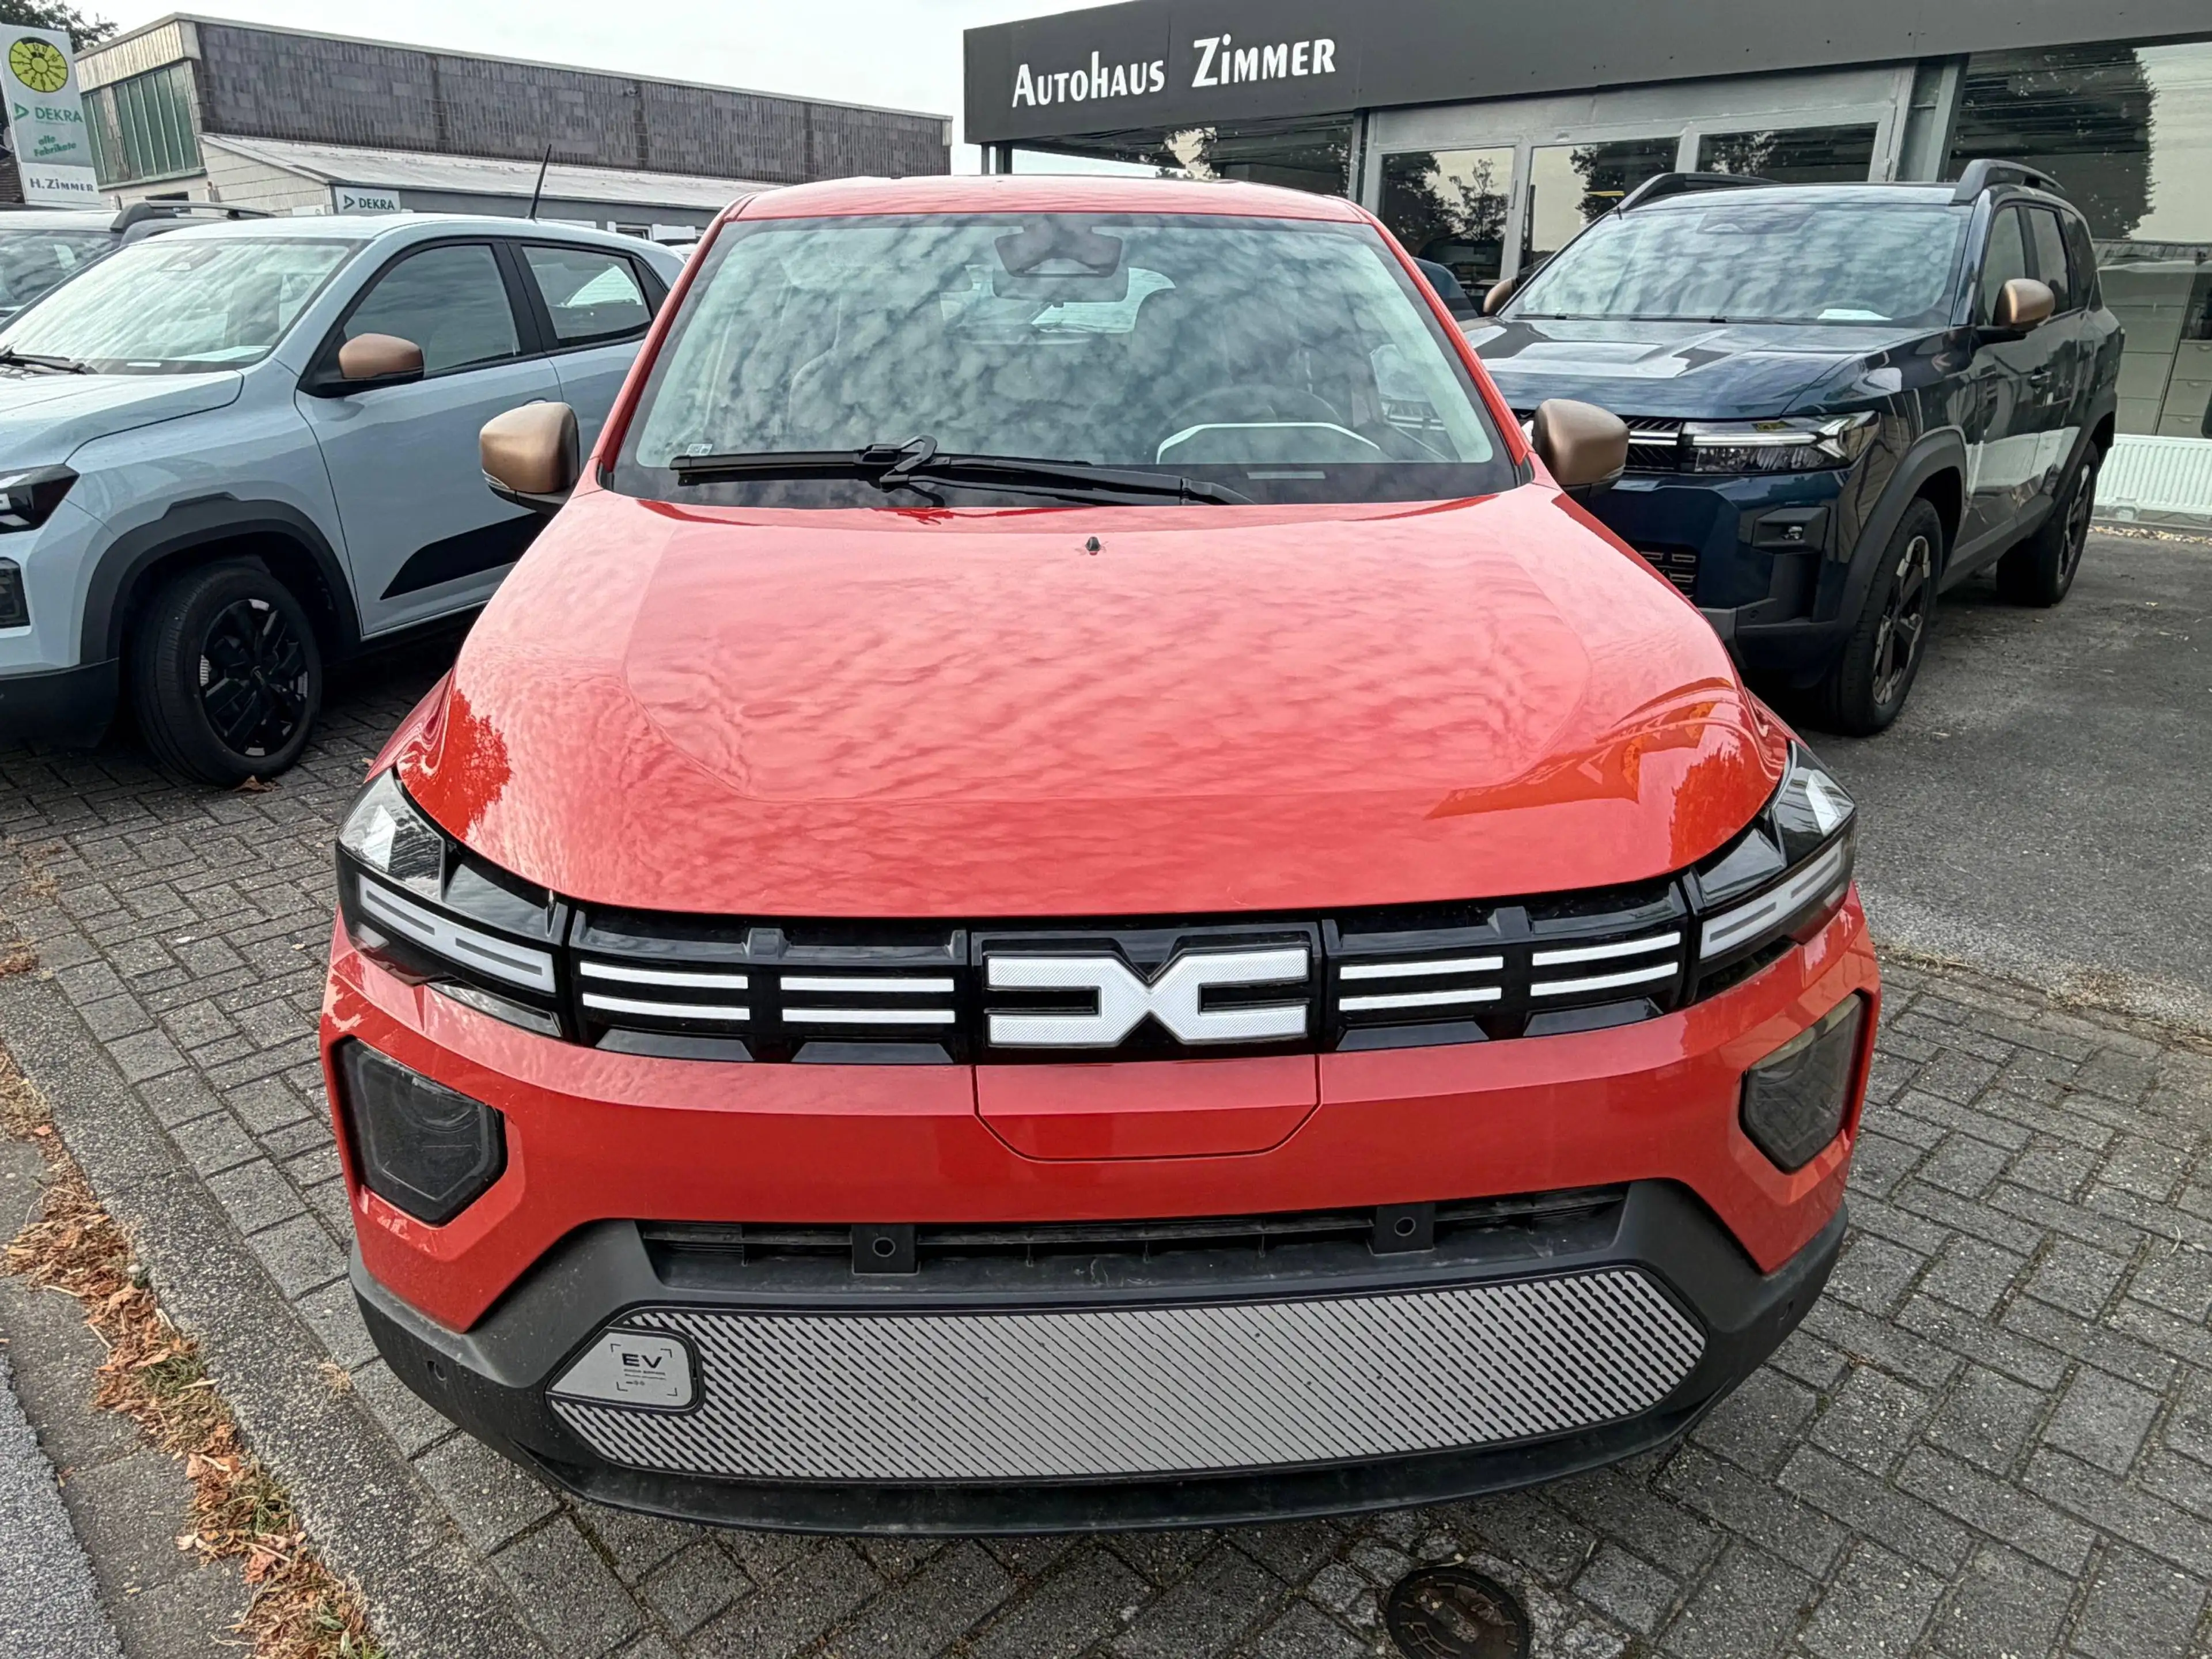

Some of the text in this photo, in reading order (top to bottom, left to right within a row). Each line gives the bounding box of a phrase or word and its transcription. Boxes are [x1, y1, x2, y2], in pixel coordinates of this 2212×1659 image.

[35, 107, 83, 123] DEKRA
[33, 143, 77, 157] Fabrikate
[358, 198, 395, 210] DEKRA
[622, 1353, 662, 1369] EV
